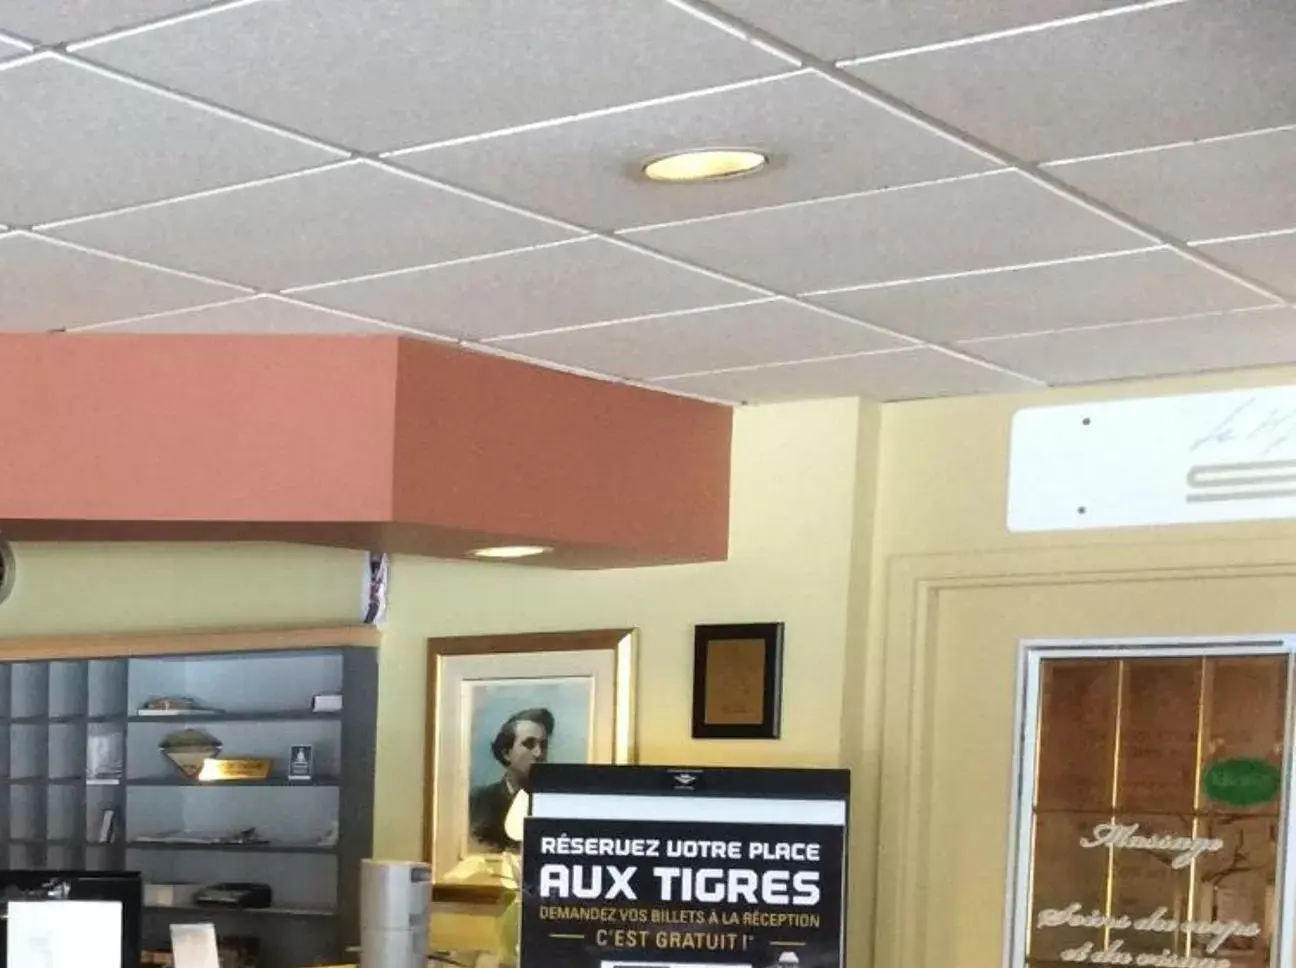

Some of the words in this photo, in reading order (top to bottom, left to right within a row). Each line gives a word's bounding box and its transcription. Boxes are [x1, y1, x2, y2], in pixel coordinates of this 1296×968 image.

[541, 832, 660, 857] RÉSERVEZ
[666, 839, 742, 859] VOTRE
[749, 842, 821, 861] PLACE
[540, 864, 638, 900] AUX
[653, 866, 820, 905] TIGRES
[539, 905, 617, 922] DEMANDEZ
[618, 908, 648, 922] VOS
[651, 909, 705, 924] BILLETS
[708, 909, 719, 925] À
[722, 911, 740, 925] LA
[743, 909, 821, 928] RÉCEPTION
[596, 928, 649, 948] C'EST
